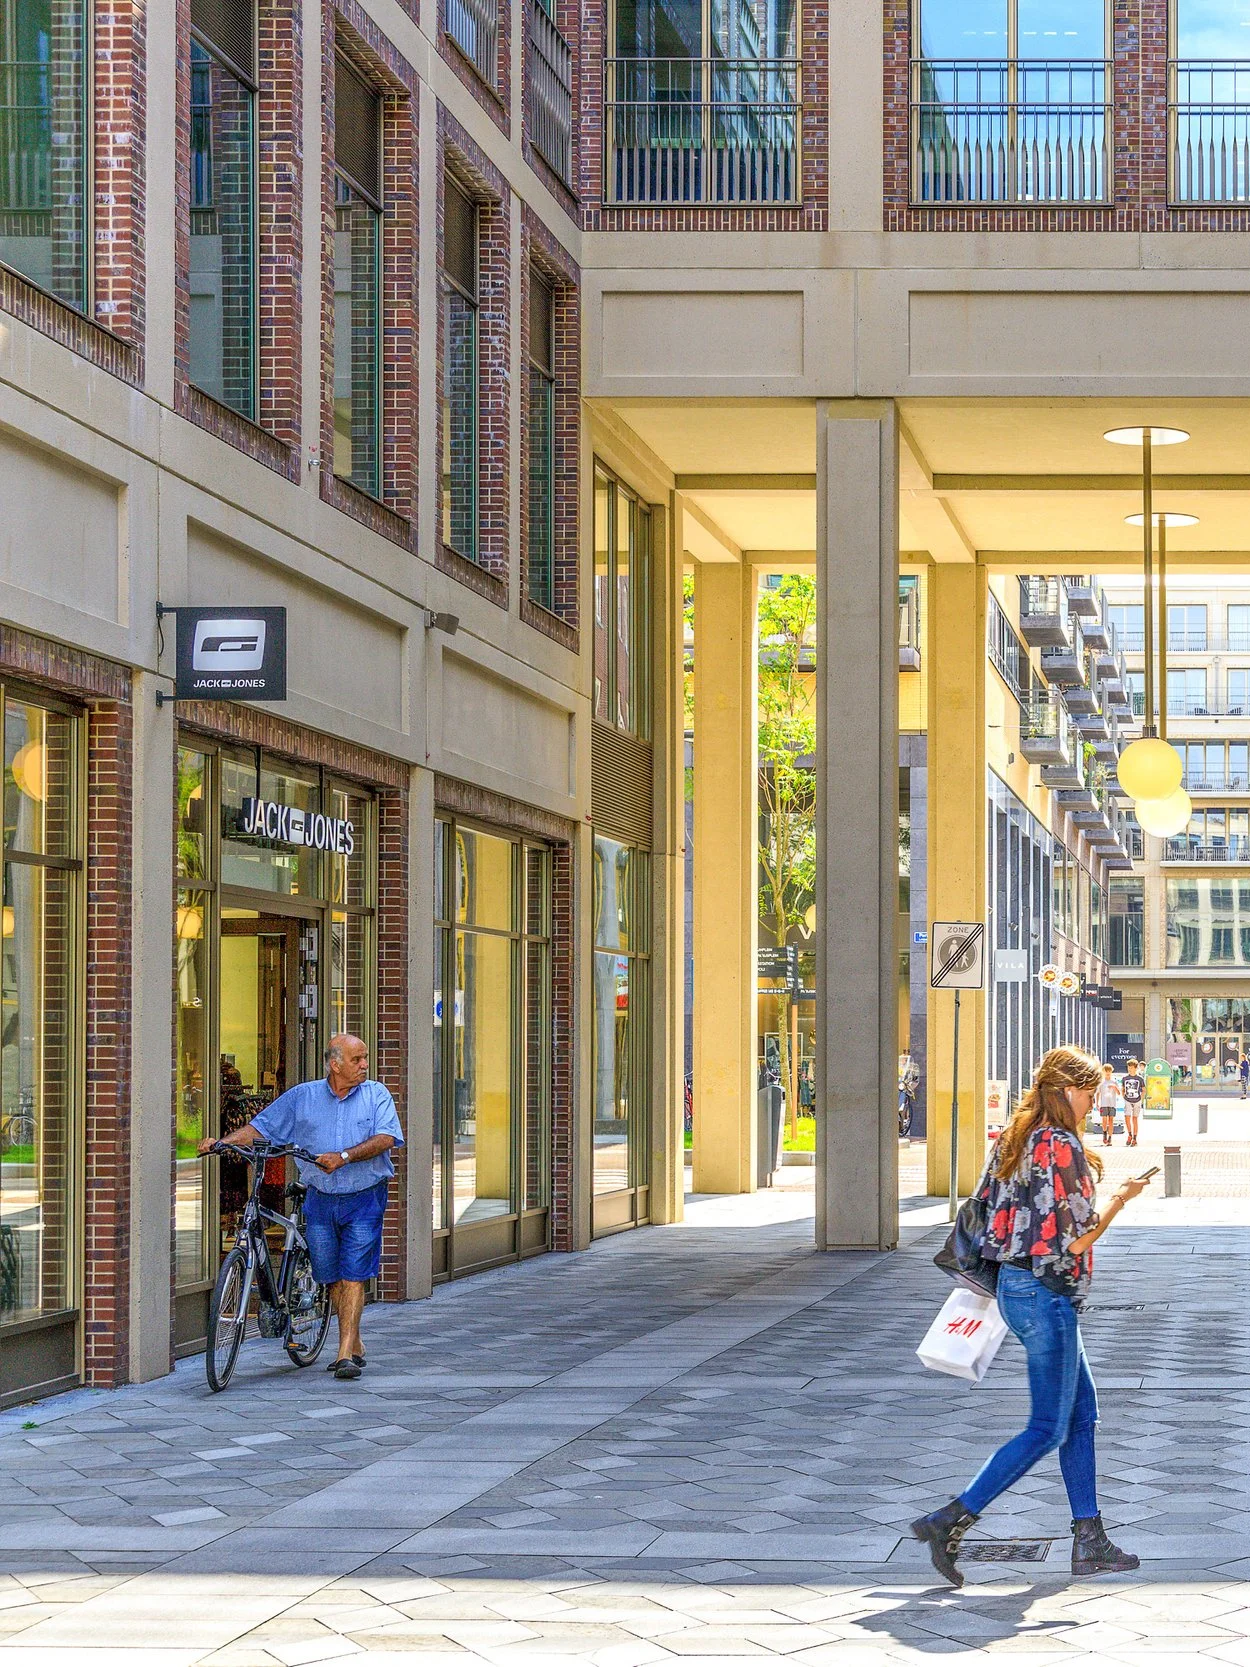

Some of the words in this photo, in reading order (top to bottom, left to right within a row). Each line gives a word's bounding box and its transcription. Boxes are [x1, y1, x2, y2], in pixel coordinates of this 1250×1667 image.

[193, 679, 221, 688] JACK
[232, 679, 266, 688] JONES
[244, 798, 289, 841] JACK
[305, 812, 354, 856] JONES
[947, 926, 969, 934] ZONE
